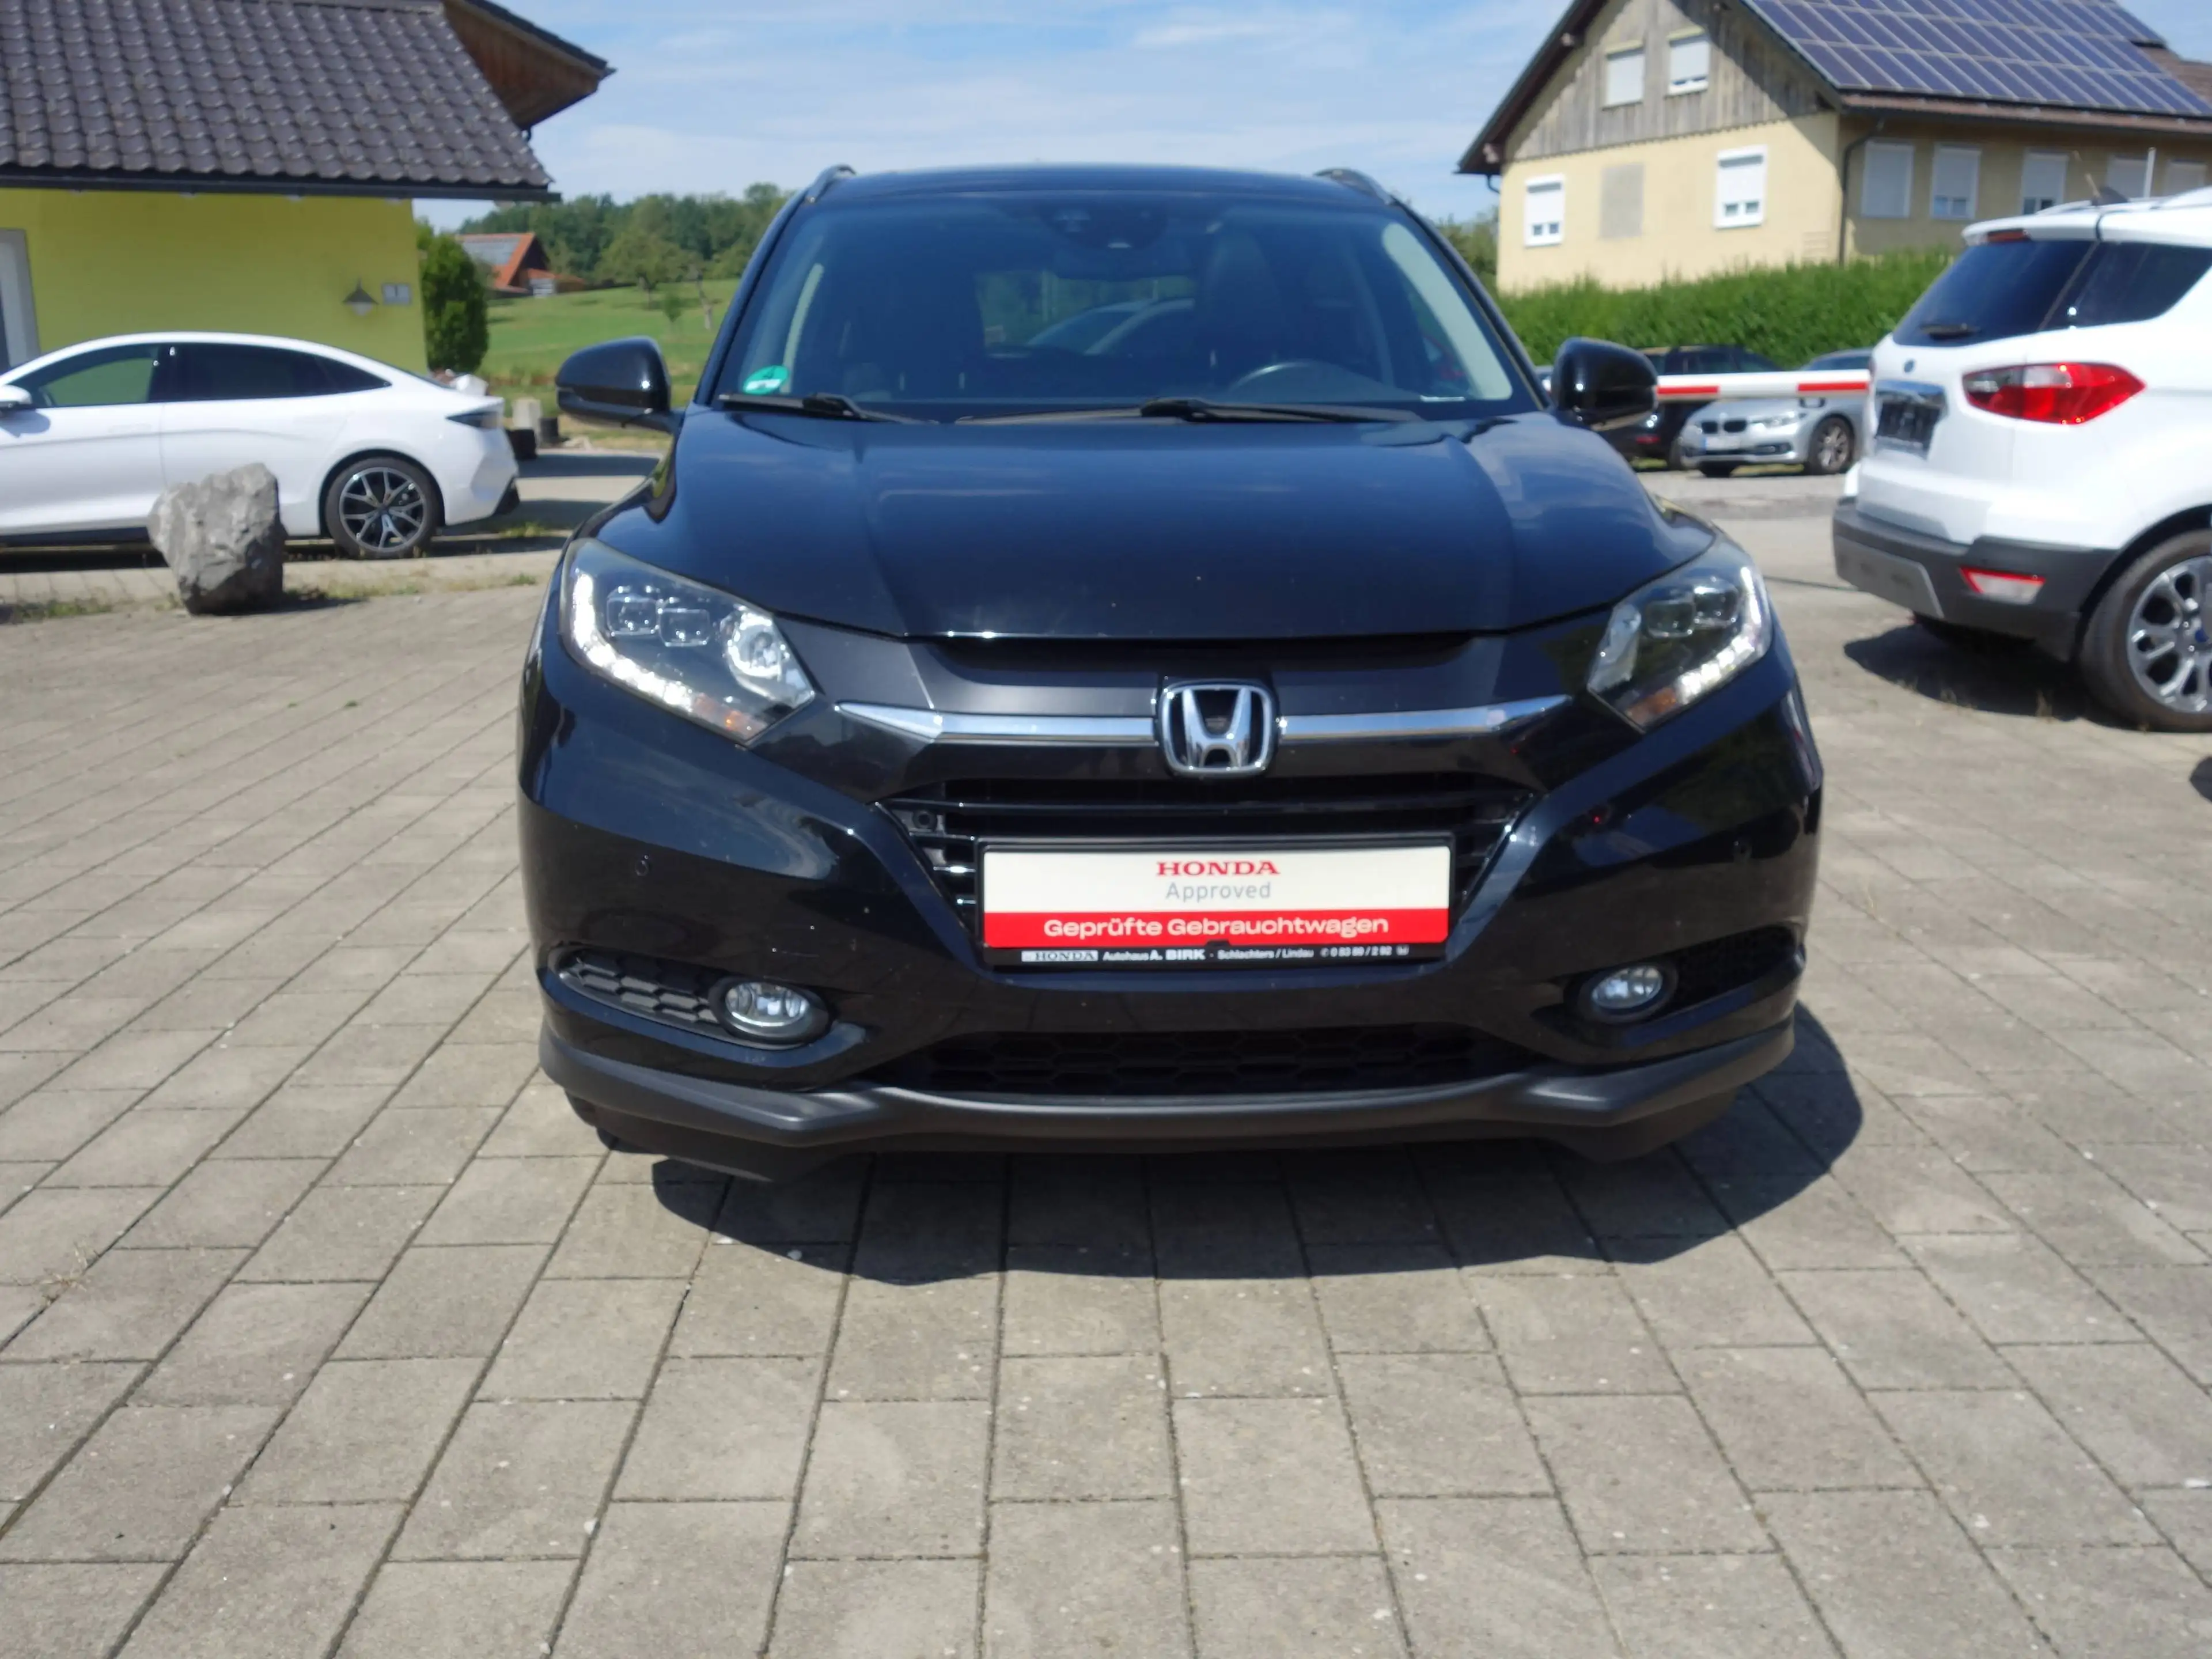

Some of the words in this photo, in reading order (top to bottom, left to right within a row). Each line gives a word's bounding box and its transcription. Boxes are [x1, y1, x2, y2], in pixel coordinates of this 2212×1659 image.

[1157, 861, 1280, 876] HONDA
[1165, 882, 1271, 902] Approved
[1044, 916, 1163, 940] Geprüfte
[1167, 916, 1389, 938] Gebrauchtwagen
[1035, 951, 1096, 961] HONDA
[1165, 948, 1206, 961] BIRK
